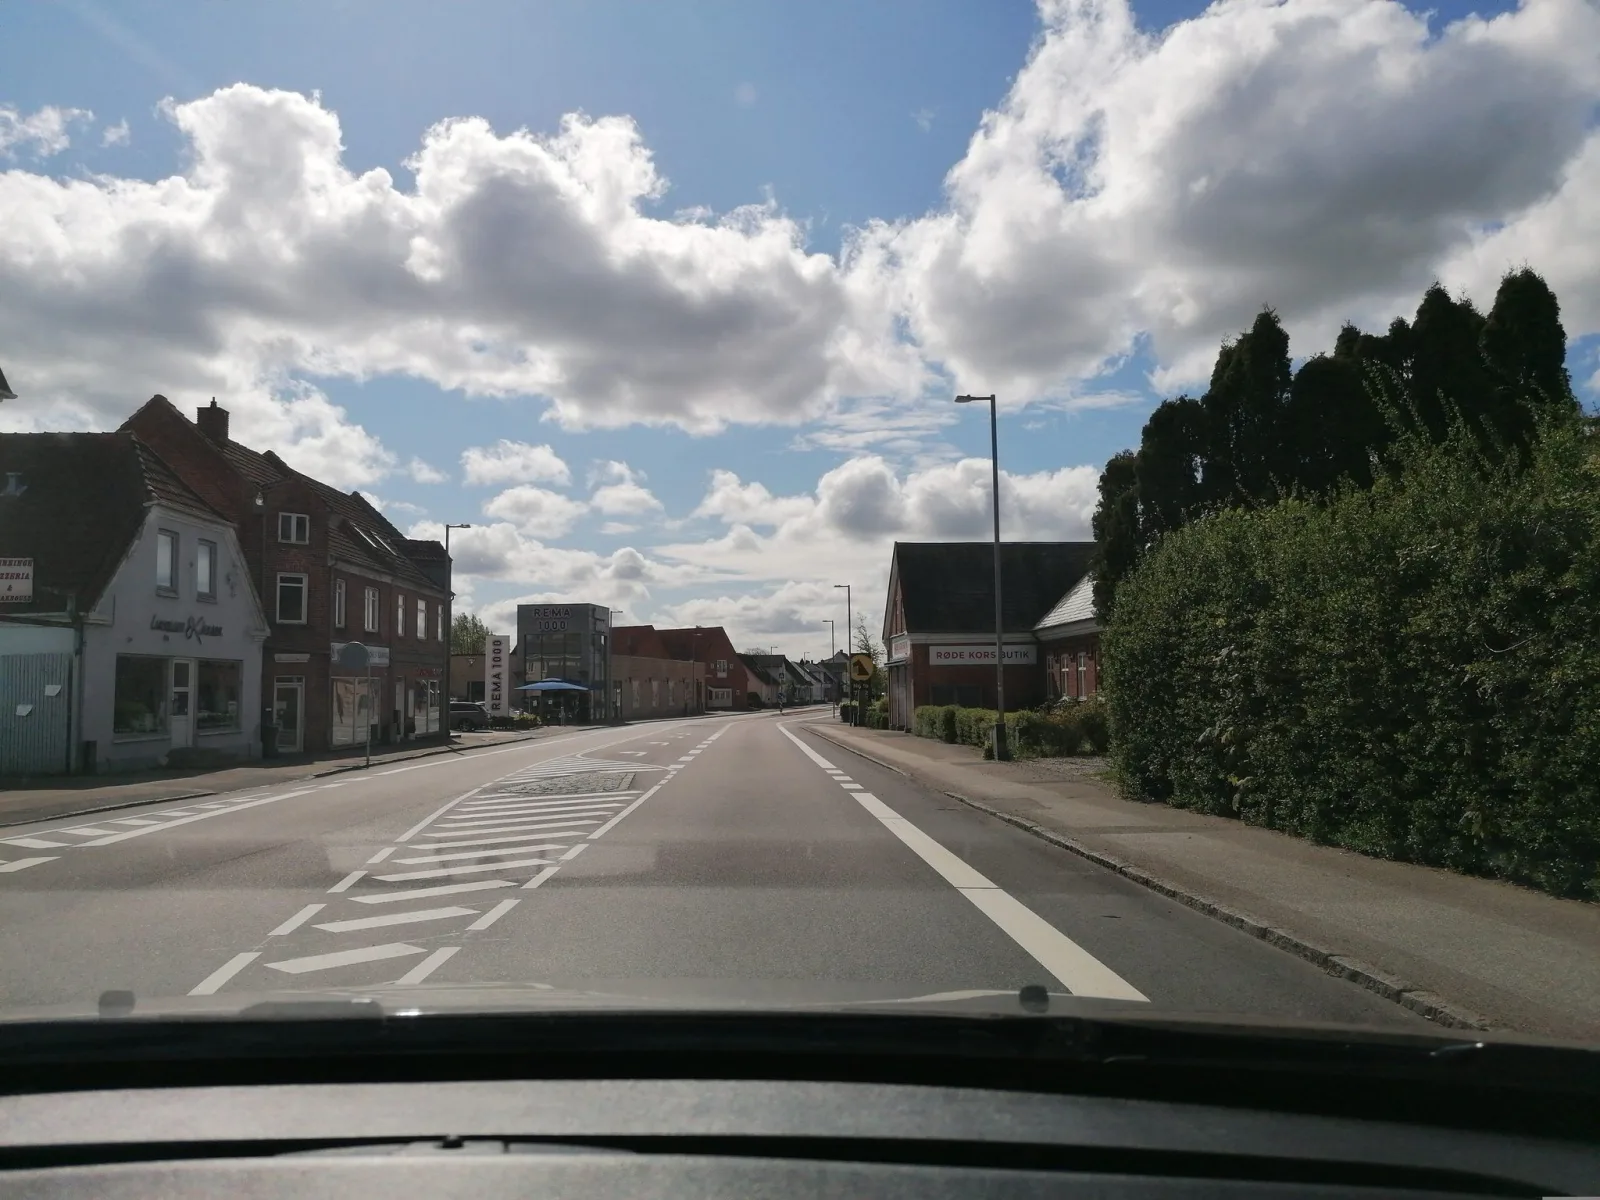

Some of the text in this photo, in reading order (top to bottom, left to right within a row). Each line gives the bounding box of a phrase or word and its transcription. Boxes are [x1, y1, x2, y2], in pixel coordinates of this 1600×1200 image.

[534, 608, 571, 618] REMA
[539, 621, 567, 630] 1000
[936, 650, 1030, 660] RØDE KORS BUTIK
[492, 640, 502, 710] REMA 1000
